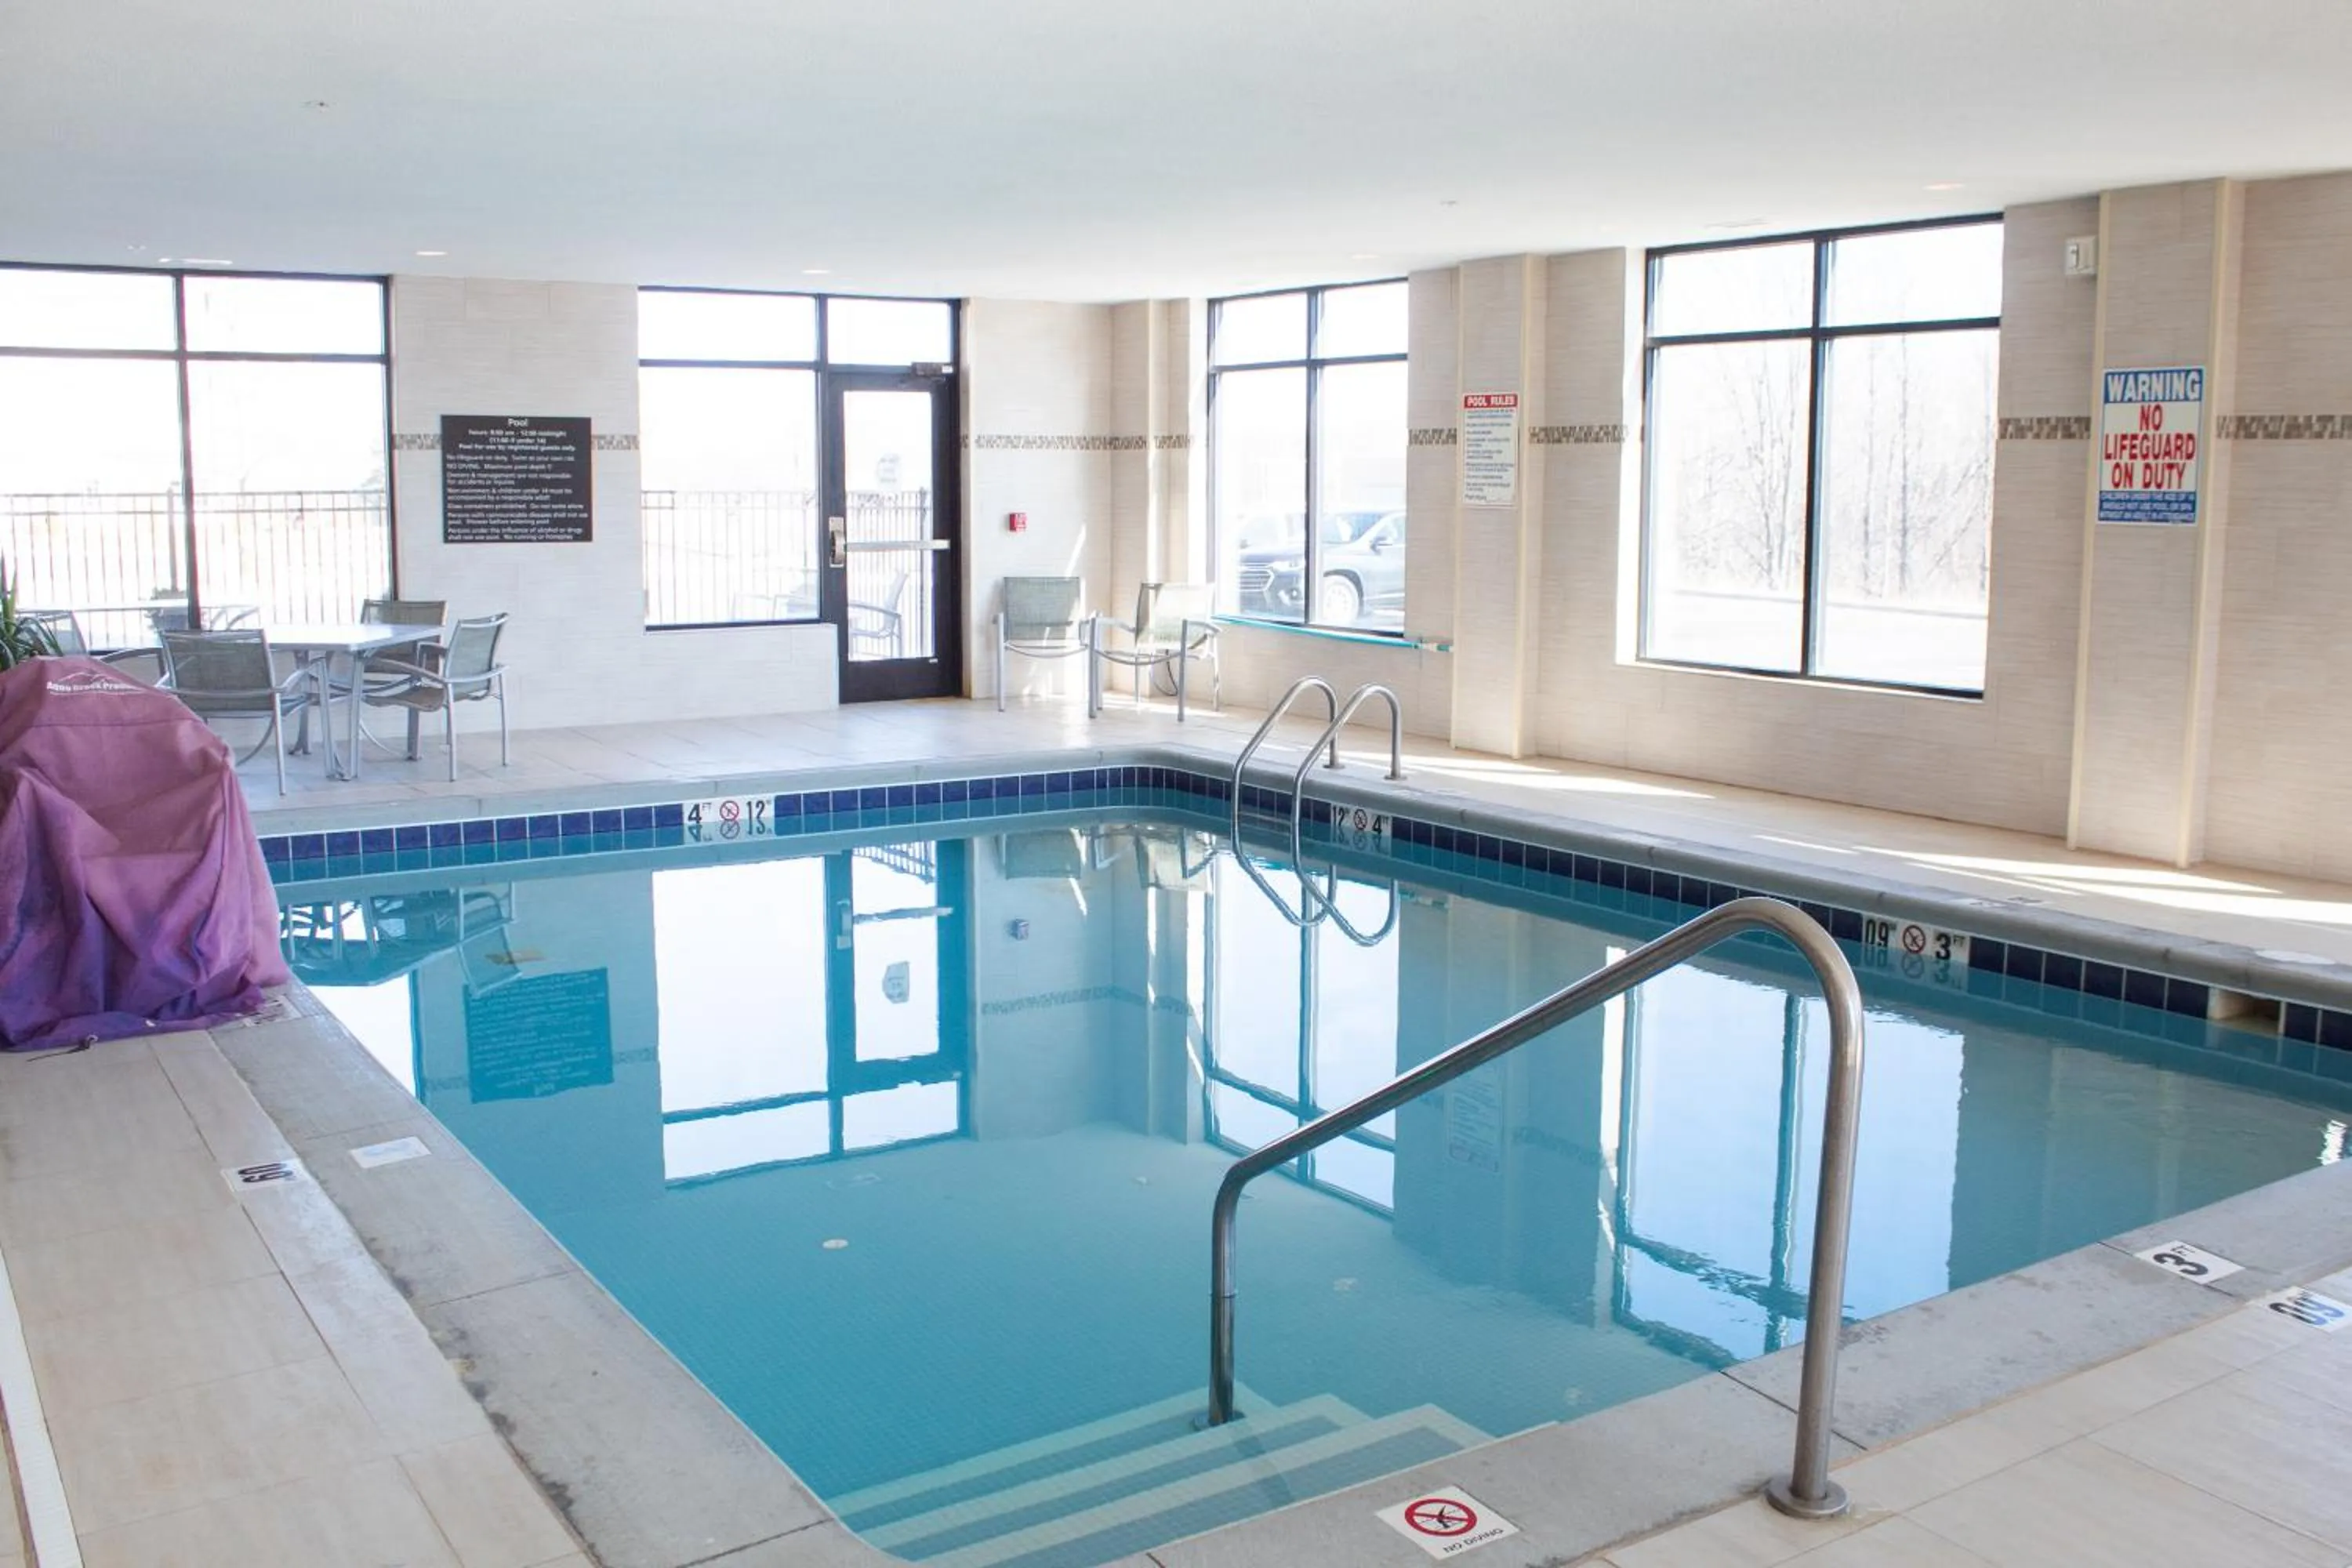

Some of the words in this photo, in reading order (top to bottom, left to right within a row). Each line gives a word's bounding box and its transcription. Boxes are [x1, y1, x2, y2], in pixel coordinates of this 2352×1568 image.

[2107, 370, 2200, 402] WARNING
[1467, 395, 1487, 407] POOL
[1491, 394, 1515, 405] RULES
[508, 418, 528, 427] Pool
[2140, 404, 2163, 431] NO
[2104, 432, 2195, 460] LIFEGUARD
[2111, 463, 2133, 489] ON
[2143, 463, 2187, 489] DUTY
[688, 803, 702, 825] 4
[1372, 815, 1382, 835] 4
[1936, 932, 1951, 960] 3
[2153, 1253, 2209, 1276] 3
[1443, 1542, 1462, 1553] NO
[1464, 1528, 1504, 1546] DIVING
